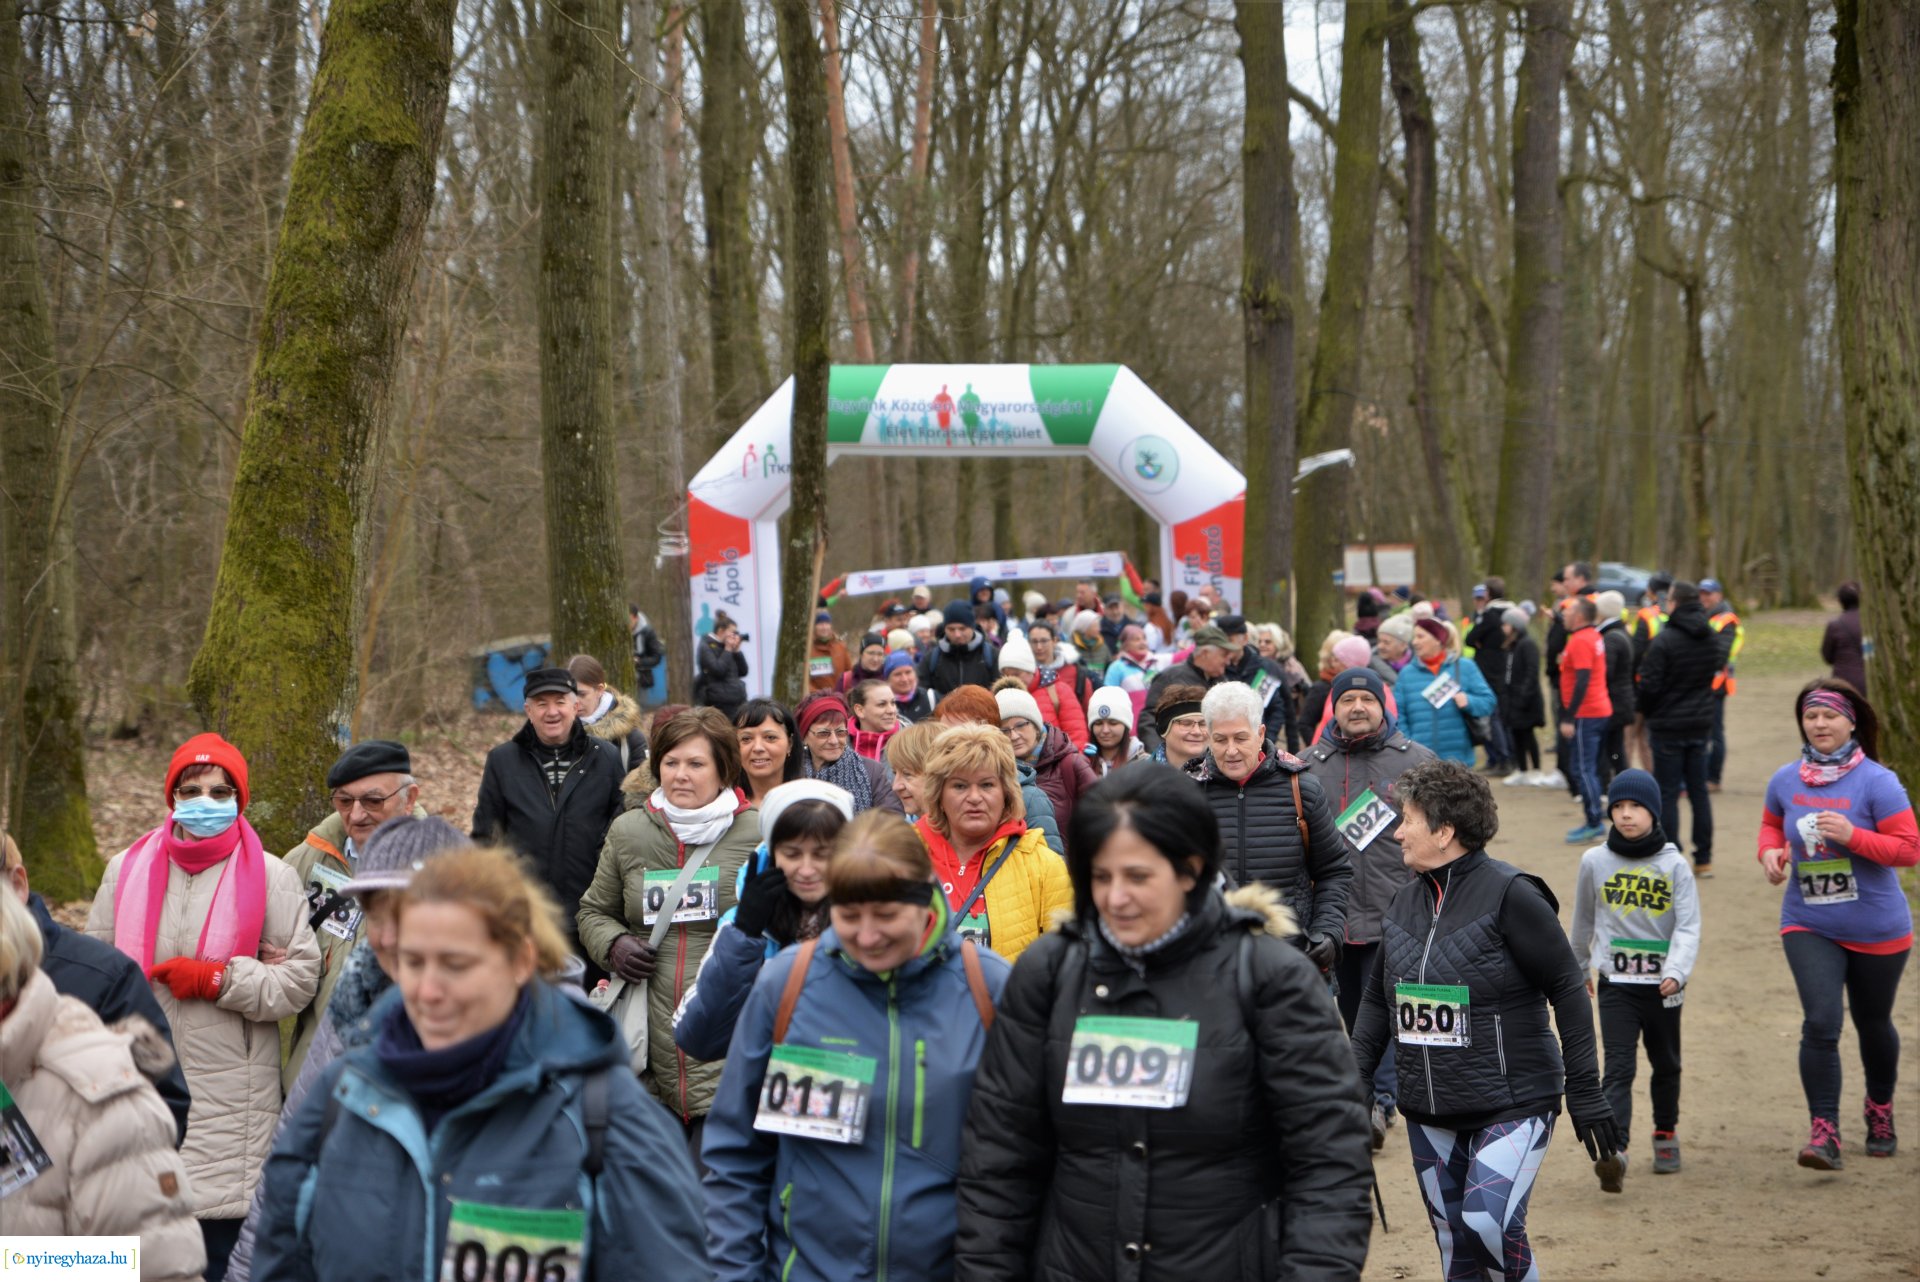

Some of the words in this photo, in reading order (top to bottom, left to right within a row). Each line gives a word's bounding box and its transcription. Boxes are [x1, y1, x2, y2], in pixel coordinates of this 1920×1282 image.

[892, 399, 953, 413] Közösen
[886, 425, 912, 439] Élet
[704, 561, 718, 592] Fitt
[720, 548, 742, 606] Ápoló
[1184, 554, 1200, 586] Fitt
[1346, 801, 1385, 841] 092
[1604, 873, 1671, 898] STAR
[1604, 888, 1671, 911] WARS
[1802, 872, 1849, 897] 179
[1614, 952, 1661, 973] 015
[1400, 1002, 1454, 1032] 050
[1077, 1044, 1169, 1085] 009
[767, 1071, 844, 1119] 011
[454, 1240, 567, 1282] 006
